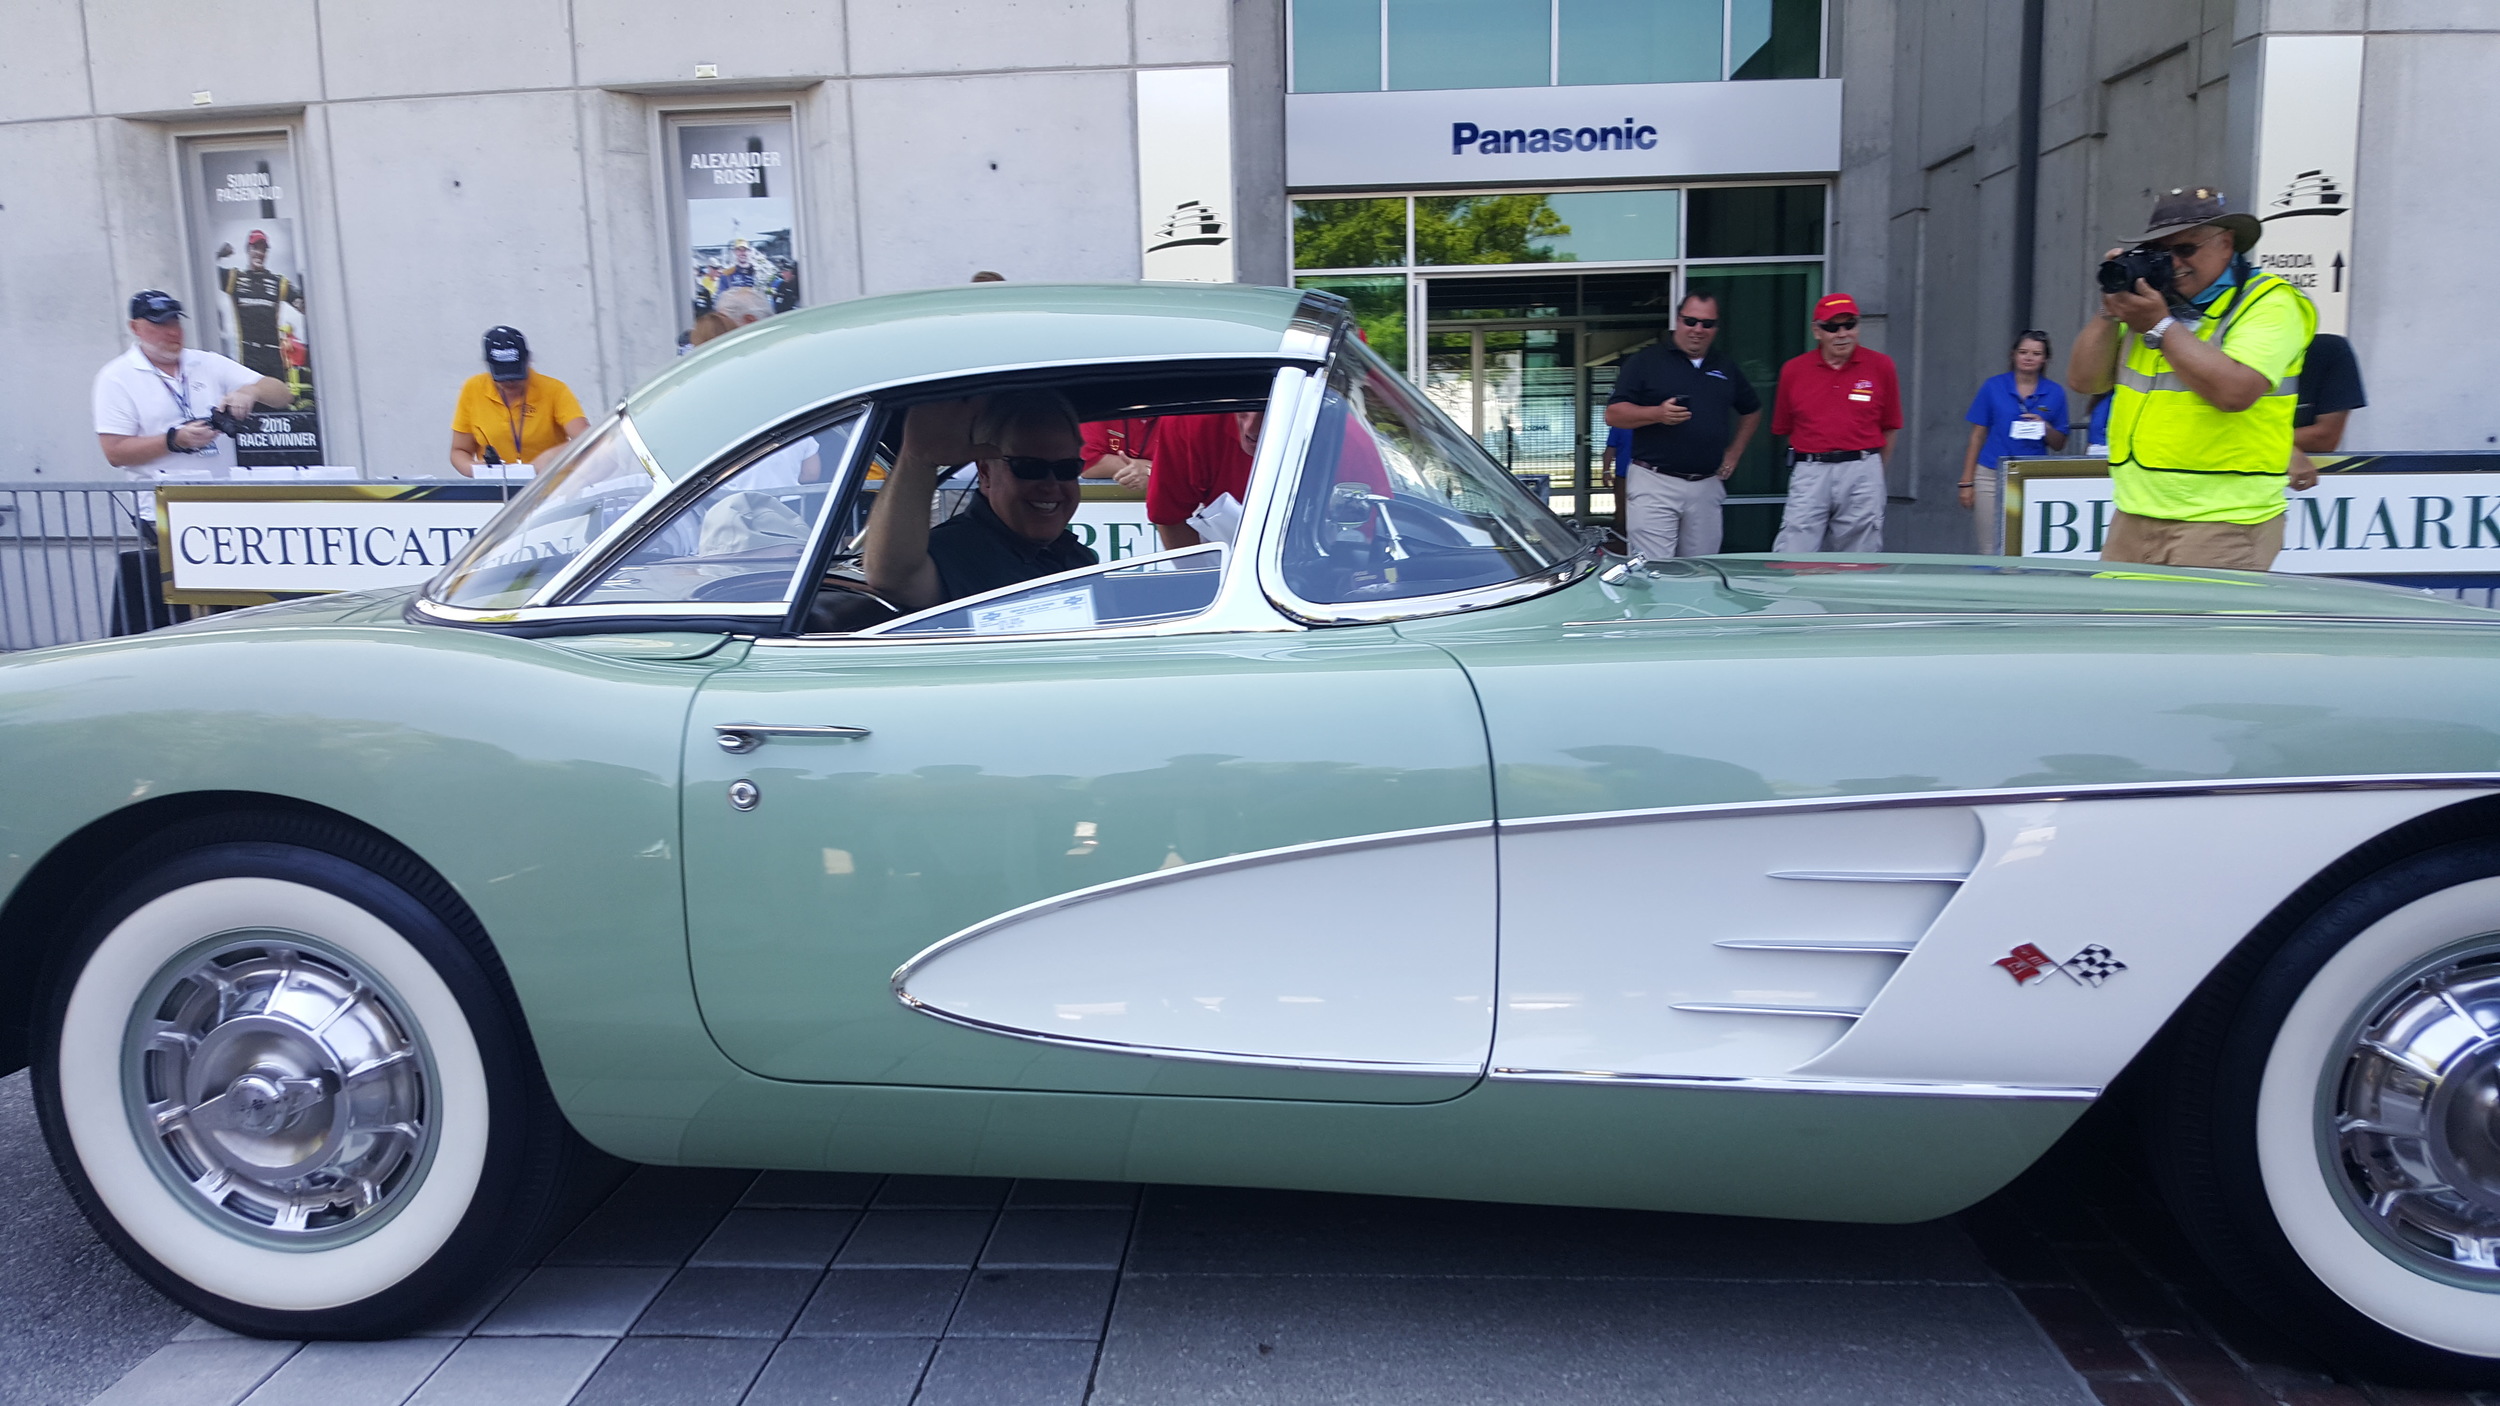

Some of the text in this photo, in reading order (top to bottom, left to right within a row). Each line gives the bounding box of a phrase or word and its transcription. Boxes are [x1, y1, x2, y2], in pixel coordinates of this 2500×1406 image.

[1452, 117, 1658, 155] Panasonic
[690, 152, 781, 169] ALEXANDER
[713, 169, 760, 184] ROSSI
[2260, 254, 2314, 268] PAGODA
[261, 418, 291, 432] 2016
[239, 433, 317, 447] RACE WINNER
